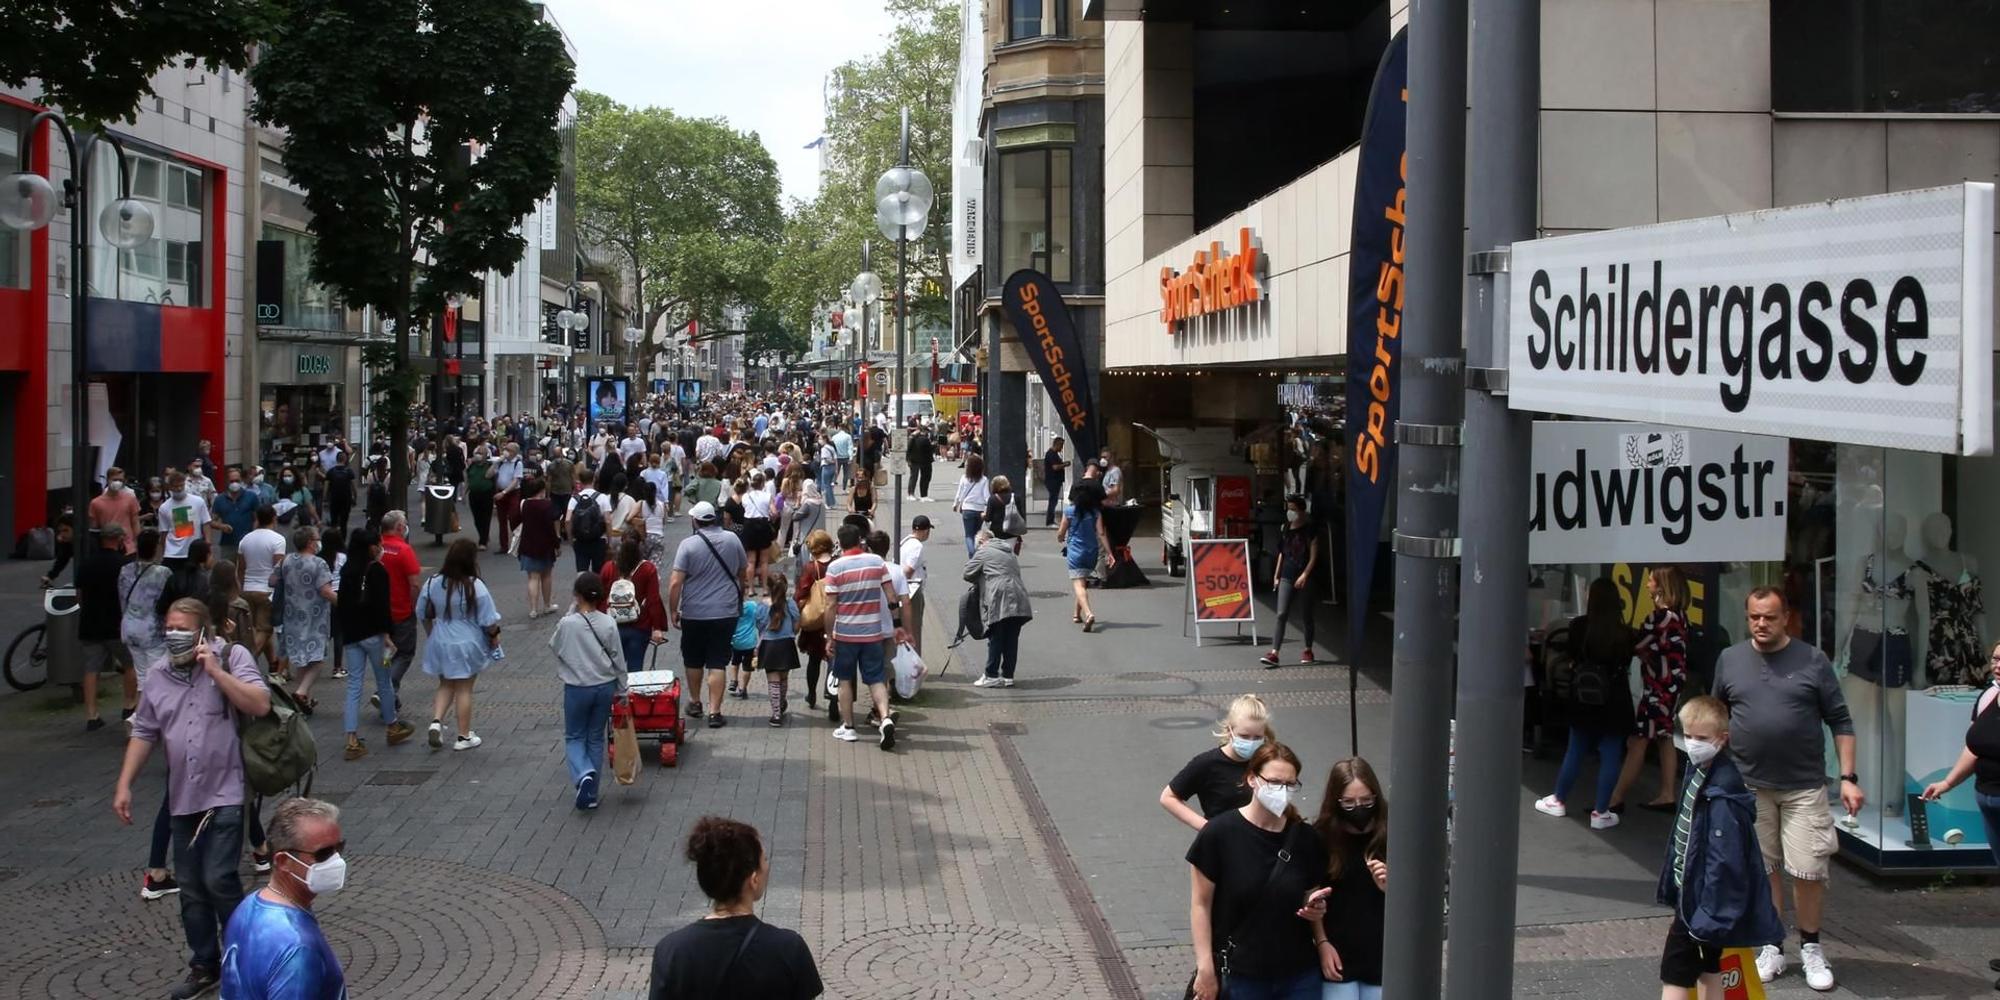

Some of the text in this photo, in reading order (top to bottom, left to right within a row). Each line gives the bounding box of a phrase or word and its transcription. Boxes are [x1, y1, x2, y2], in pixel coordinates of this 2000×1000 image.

[1160, 227, 1260, 335] SportScheck
[1357, 92, 1407, 482] SportSch
[1019, 281, 1090, 432] SportScheck
[1528, 260, 1930, 413] Schildergasse
[1529, 444, 1784, 545] udwigstr.
[1198, 574, 1248, 591] -50%
[1720, 968, 1741, 990] GO
